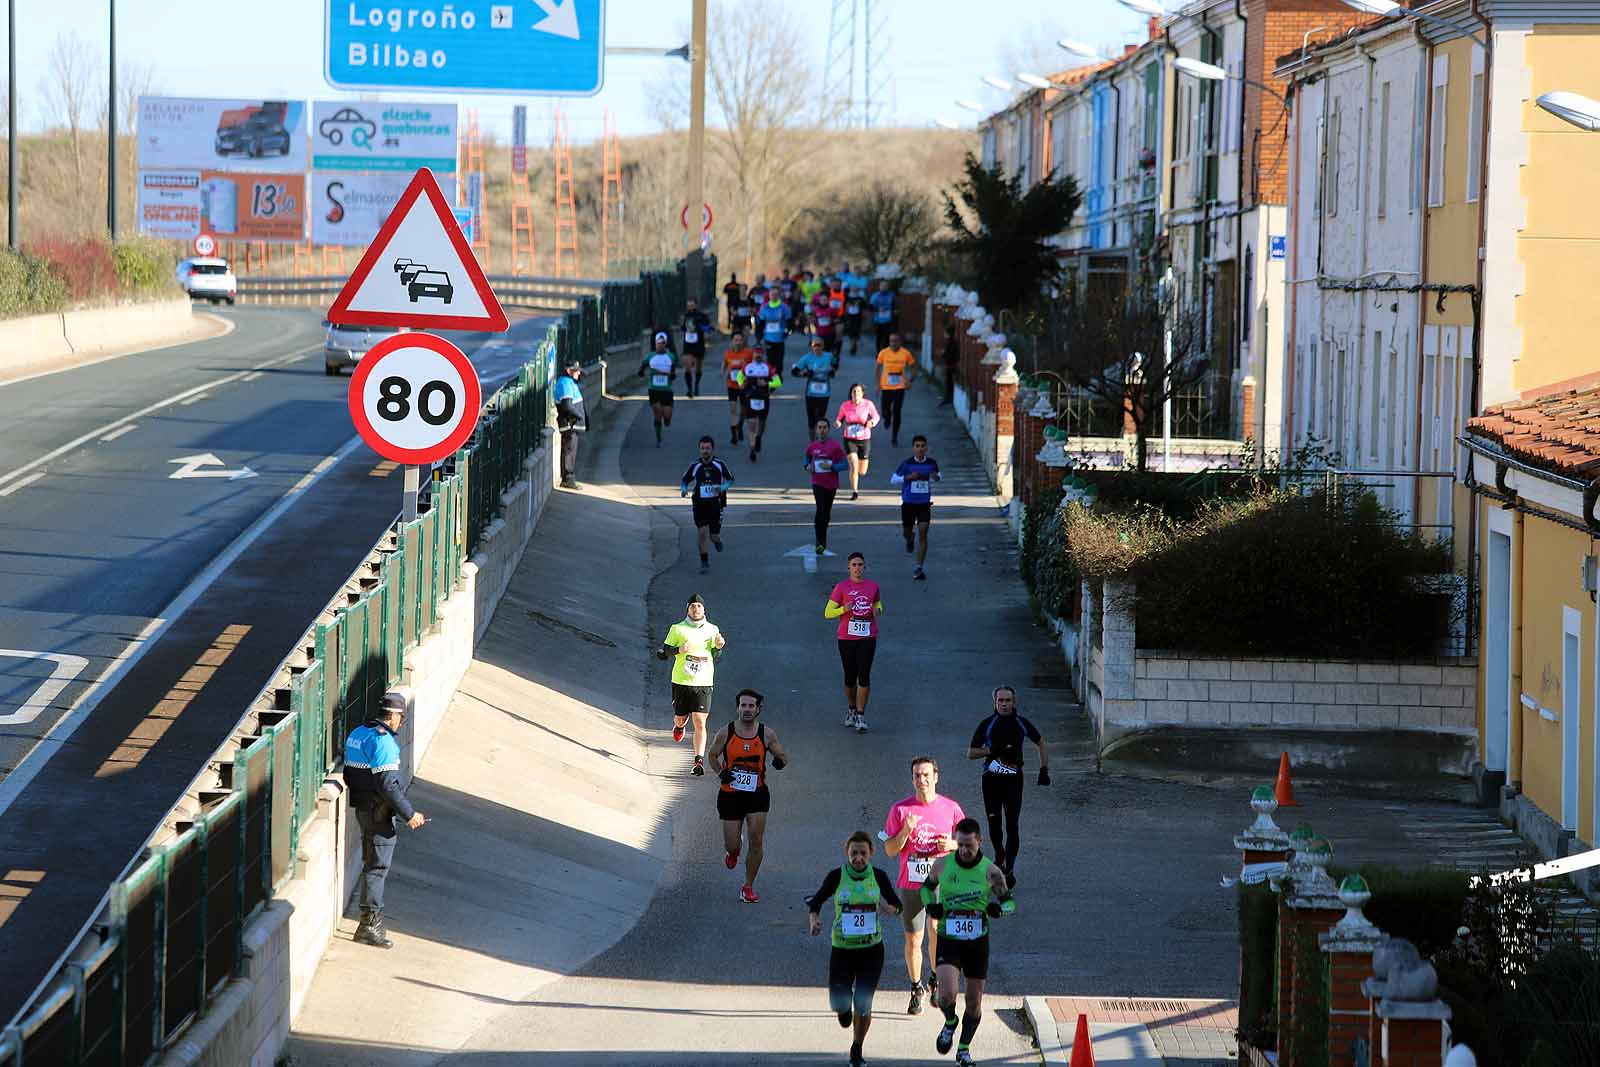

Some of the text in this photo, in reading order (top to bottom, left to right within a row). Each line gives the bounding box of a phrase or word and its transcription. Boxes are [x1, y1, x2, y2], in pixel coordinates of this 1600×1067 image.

[349, 3, 476, 32] Logroño
[349, 43, 447, 68] Bilbao
[377, 376, 455, 425] 80
[854, 623, 866, 631] 518
[736, 774, 752, 785] 328
[854, 915, 865, 927] 28
[955, 921, 974, 933] 346
